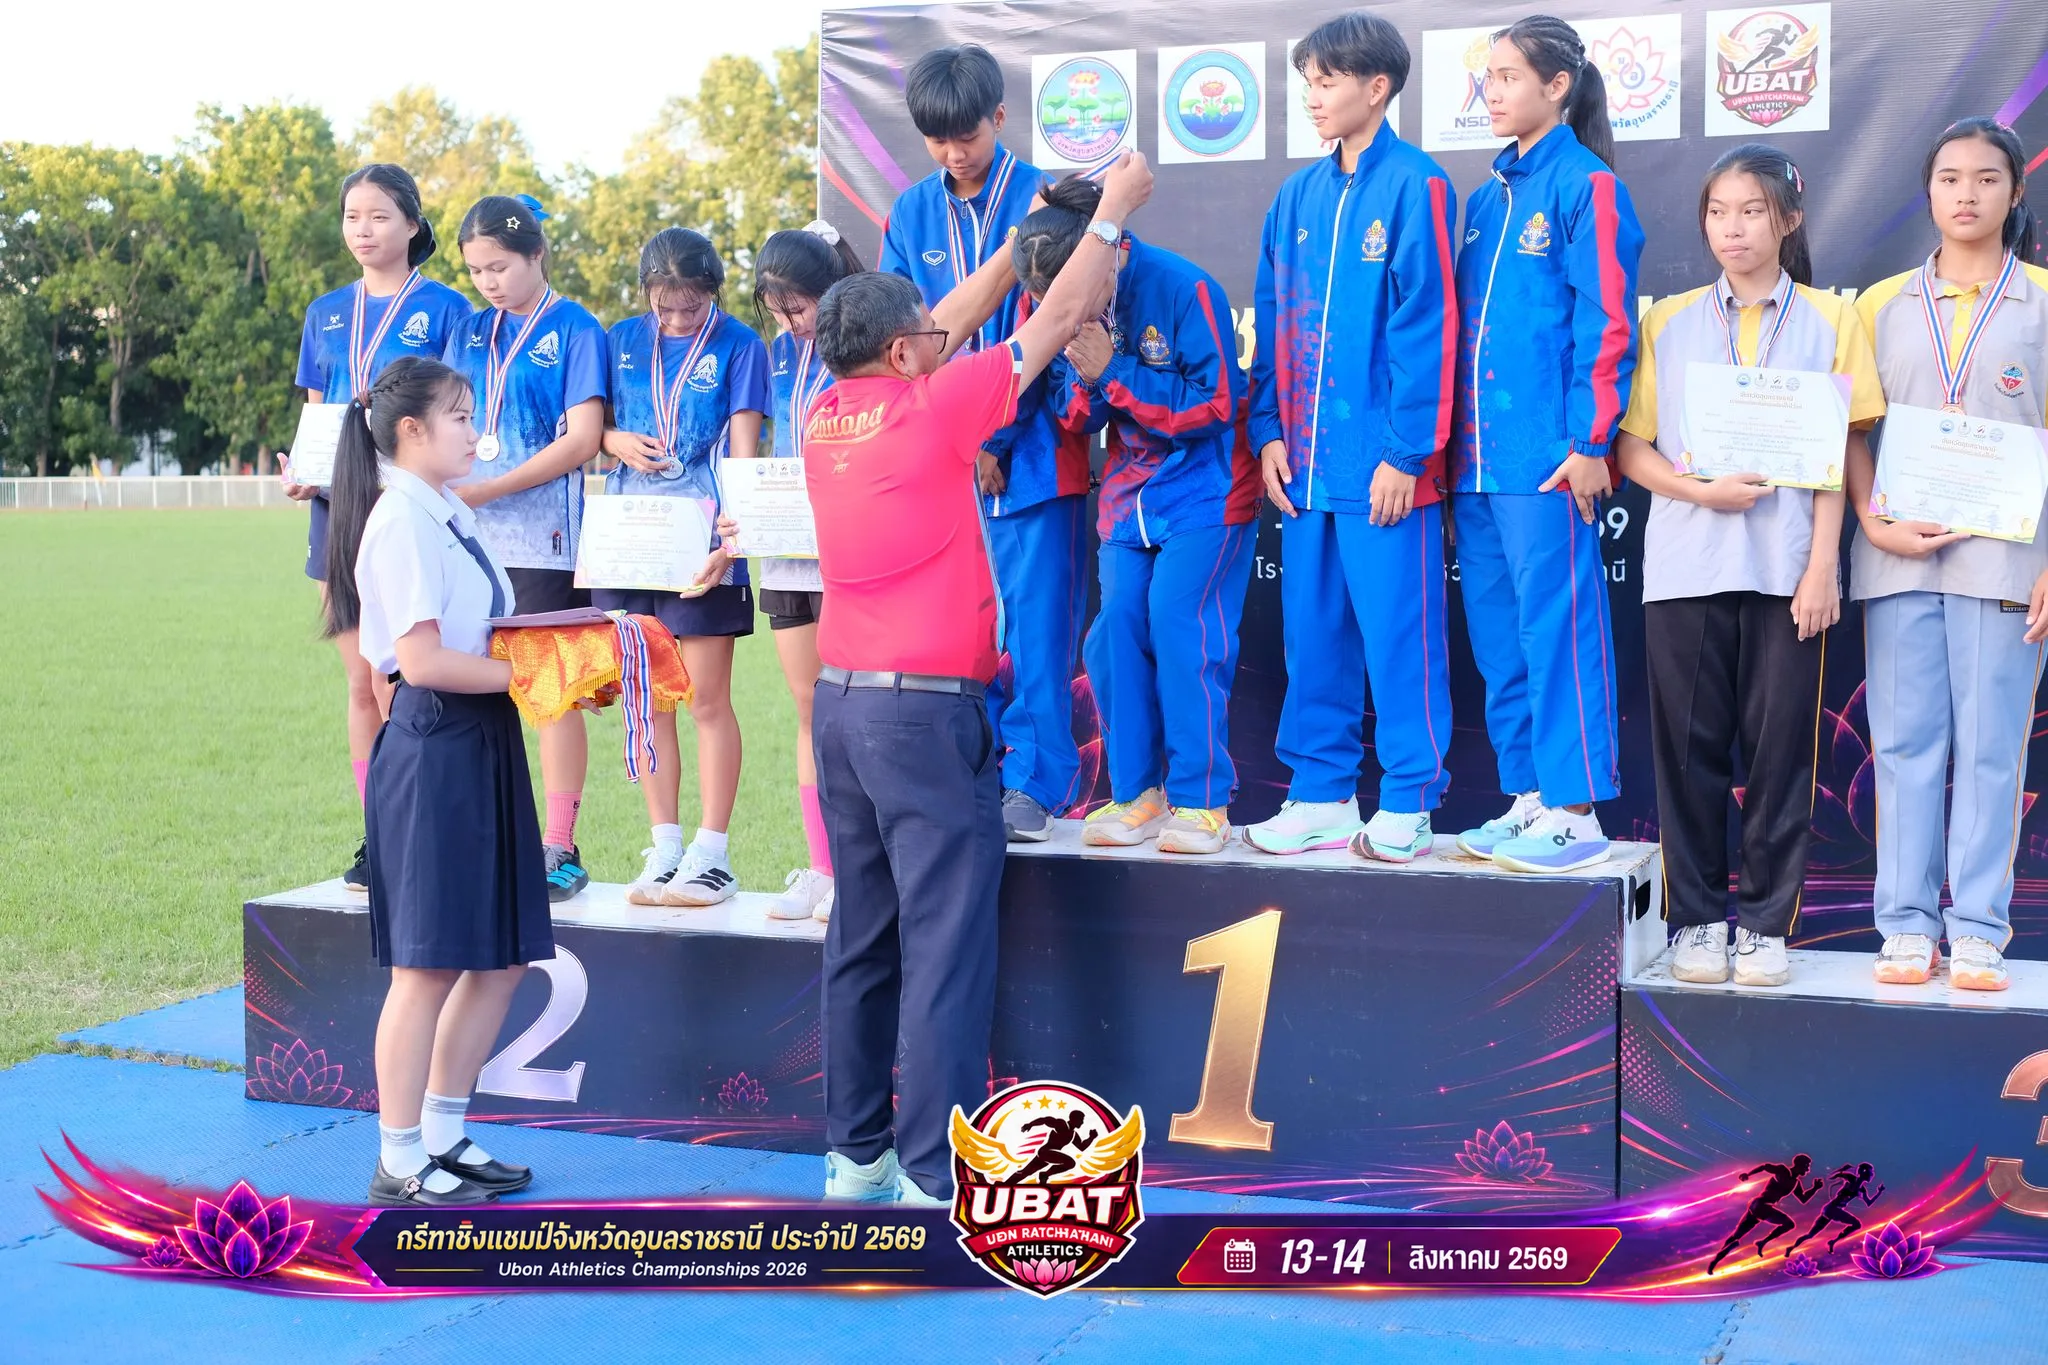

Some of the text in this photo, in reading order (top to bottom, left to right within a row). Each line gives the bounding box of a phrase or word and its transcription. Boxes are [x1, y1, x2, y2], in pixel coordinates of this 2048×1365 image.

[1724, 68, 1810, 96] UBAT
[1746, 101, 1788, 110] ATHLETICS
[475, 943, 589, 1103] 2
[1167, 910, 1282, 1152] 1
